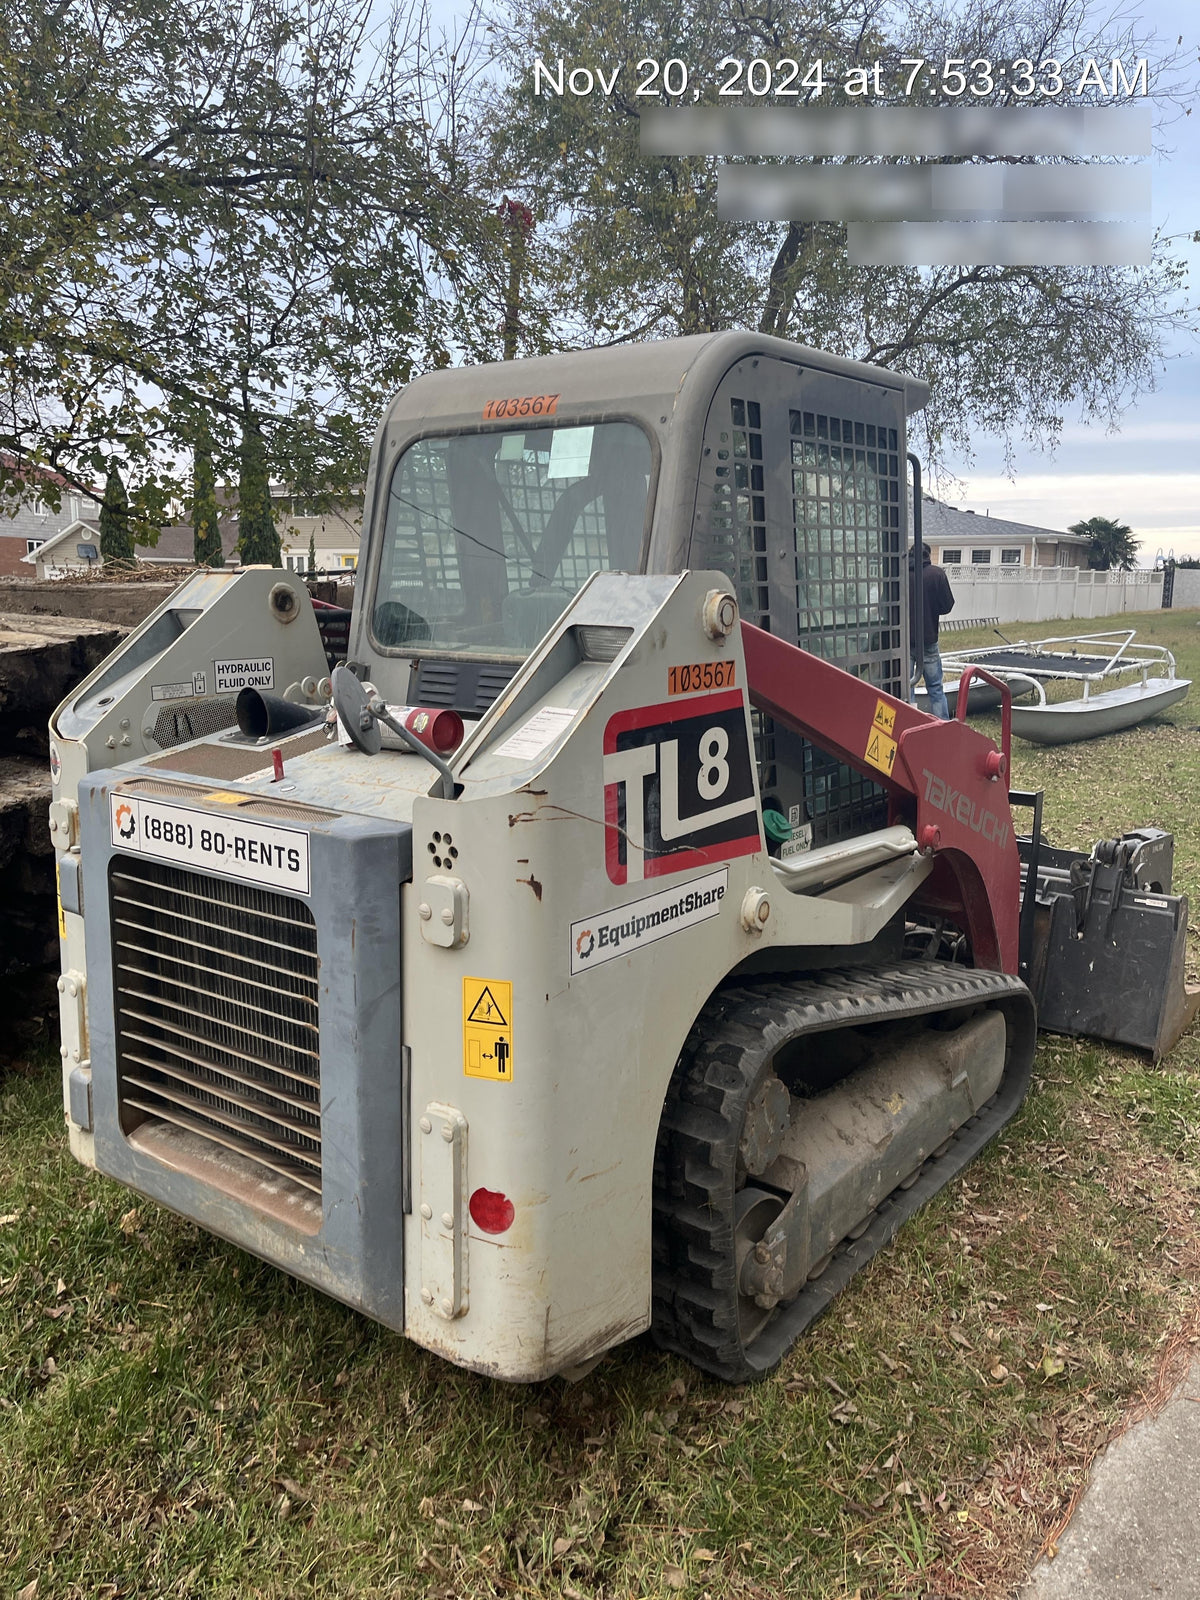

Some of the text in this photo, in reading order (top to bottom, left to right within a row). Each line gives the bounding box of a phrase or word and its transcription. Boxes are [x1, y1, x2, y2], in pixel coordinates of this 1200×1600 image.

[487, 394, 560, 418] 103567
[217, 662, 271, 675] HYDRAULIC
[670, 661, 735, 692] 103567
[218, 676, 271, 689] FLUID ONLY
[144, 815, 300, 873] (888) 80-RENTS
[597, 885, 725, 949] EquipmentShare
